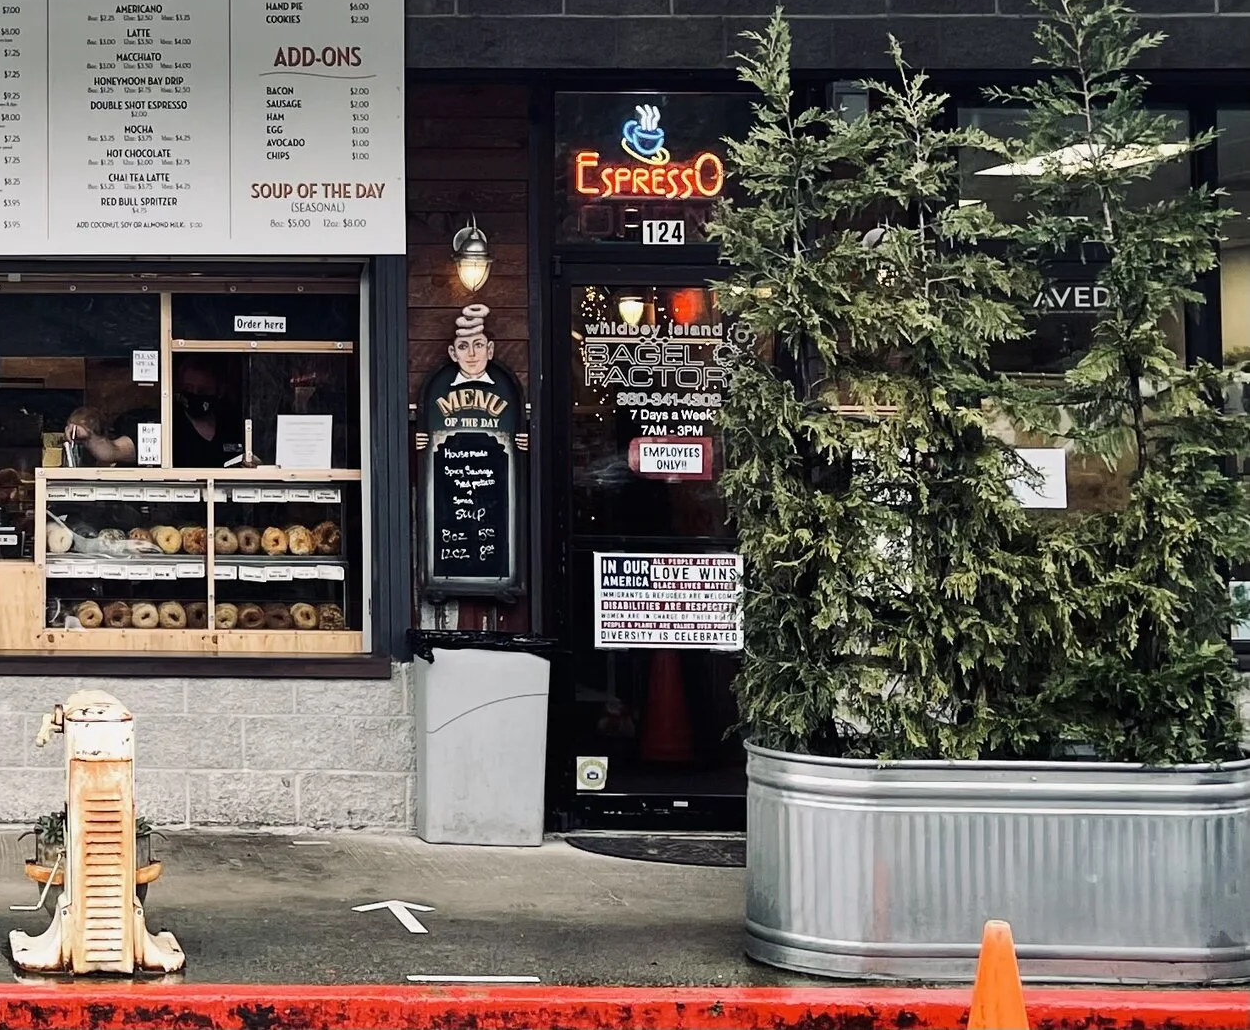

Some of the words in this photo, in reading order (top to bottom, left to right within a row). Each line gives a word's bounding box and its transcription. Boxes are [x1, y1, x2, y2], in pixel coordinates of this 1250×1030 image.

[116, 5, 163, 14] AMERICANO
[266, 2, 289, 11] HAND
[291, 2, 303, 10] PIE
[350, 3, 369, 11] $6.00
[127, 29, 151, 38] LATTE
[4, 49, 20, 57] $7.25
[117, 53, 161, 61] MACCHIATO
[274, 47, 361, 67] ADD-ONS
[3, 92, 20, 100] $9.25
[90, 101, 123, 110] DOUBLE
[125, 101, 145, 110] SHOT
[148, 101, 187, 110] ESPRESSO
[266, 100, 302, 108] SAUSAGE
[350, 101, 369, 109] $2.00
[1, 113, 20, 122] $8.00
[267, 139, 305, 147] AVOCADO
[107, 149, 123, 158] HOT
[125, 149, 171, 158] CHOCOLATE
[267, 152, 290, 160] CHIPS
[251, 183, 293, 198] SOUP
[297, 183, 318, 198] OF
[322, 183, 351, 198] THE
[356, 183, 385, 198] DAY
[101, 198, 117, 206] RED
[119, 198, 139, 206] BULL
[141, 198, 177, 206] SPRITZER
[291, 202, 345, 213] (SEASONAL)
[288, 219, 311, 228] $5.00
[343, 219, 366, 228] $8.00
[646, 222, 682, 243] 124
[237, 319, 262, 329] Order
[265, 320, 284, 330] here
[585, 322, 661, 338] whidbey
[669, 322, 723, 336] island
[585, 344, 704, 366] BAGEL
[436, 389, 508, 417] MENU
[617, 392, 722, 407] 360-341-4302
[630, 410, 637, 420] 7
[641, 410, 668, 422] Days
[671, 412, 679, 420] a
[681, 409, 715, 421] Week
[444, 418, 458, 427] OF
[461, 418, 478, 427] THE
[480, 419, 500, 428] DAY
[641, 425, 667, 436] 7AM
[678, 425, 703, 436] 3PM
[643, 447, 700, 457] EMPLOYEES
[603, 560, 617, 574] IN
[624, 560, 649, 574] OUR
[654, 568, 690, 580] LOVE
[699, 568, 736, 580] WINS
[603, 576, 649, 587] AMERICA
[603, 602, 660, 610] DISABILITIES
[664, 602, 681, 610] ARE
[601, 631, 653, 640] DIVERSITY
[660, 632, 668, 640] IS
[675, 632, 737, 641] CELEBRATED
